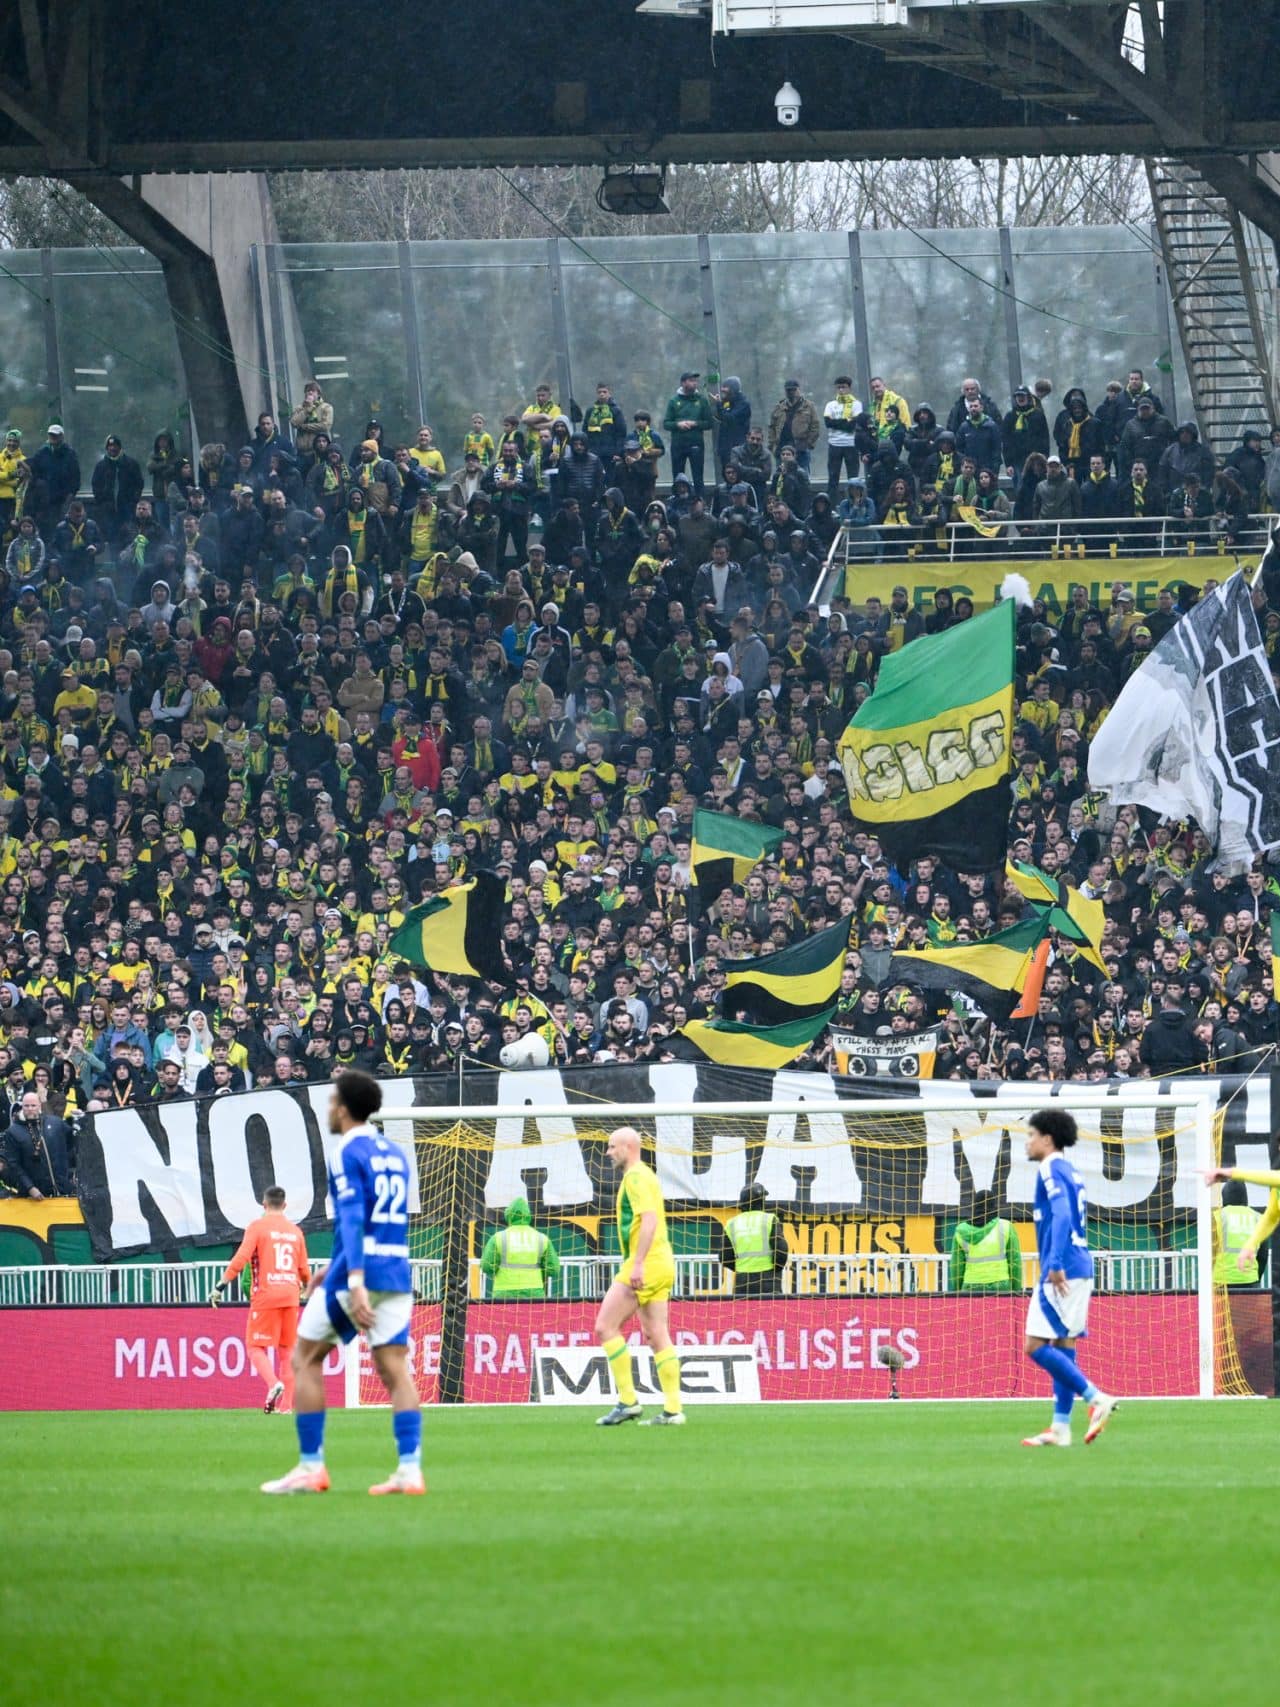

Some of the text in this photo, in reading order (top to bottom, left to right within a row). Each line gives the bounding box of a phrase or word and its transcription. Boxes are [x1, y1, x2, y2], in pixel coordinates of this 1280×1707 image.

[484, 1069, 594, 1208] A
[648, 1063, 862, 1204] LA
[371, 1174, 408, 1225] 22
[273, 1243, 294, 1271] 16
